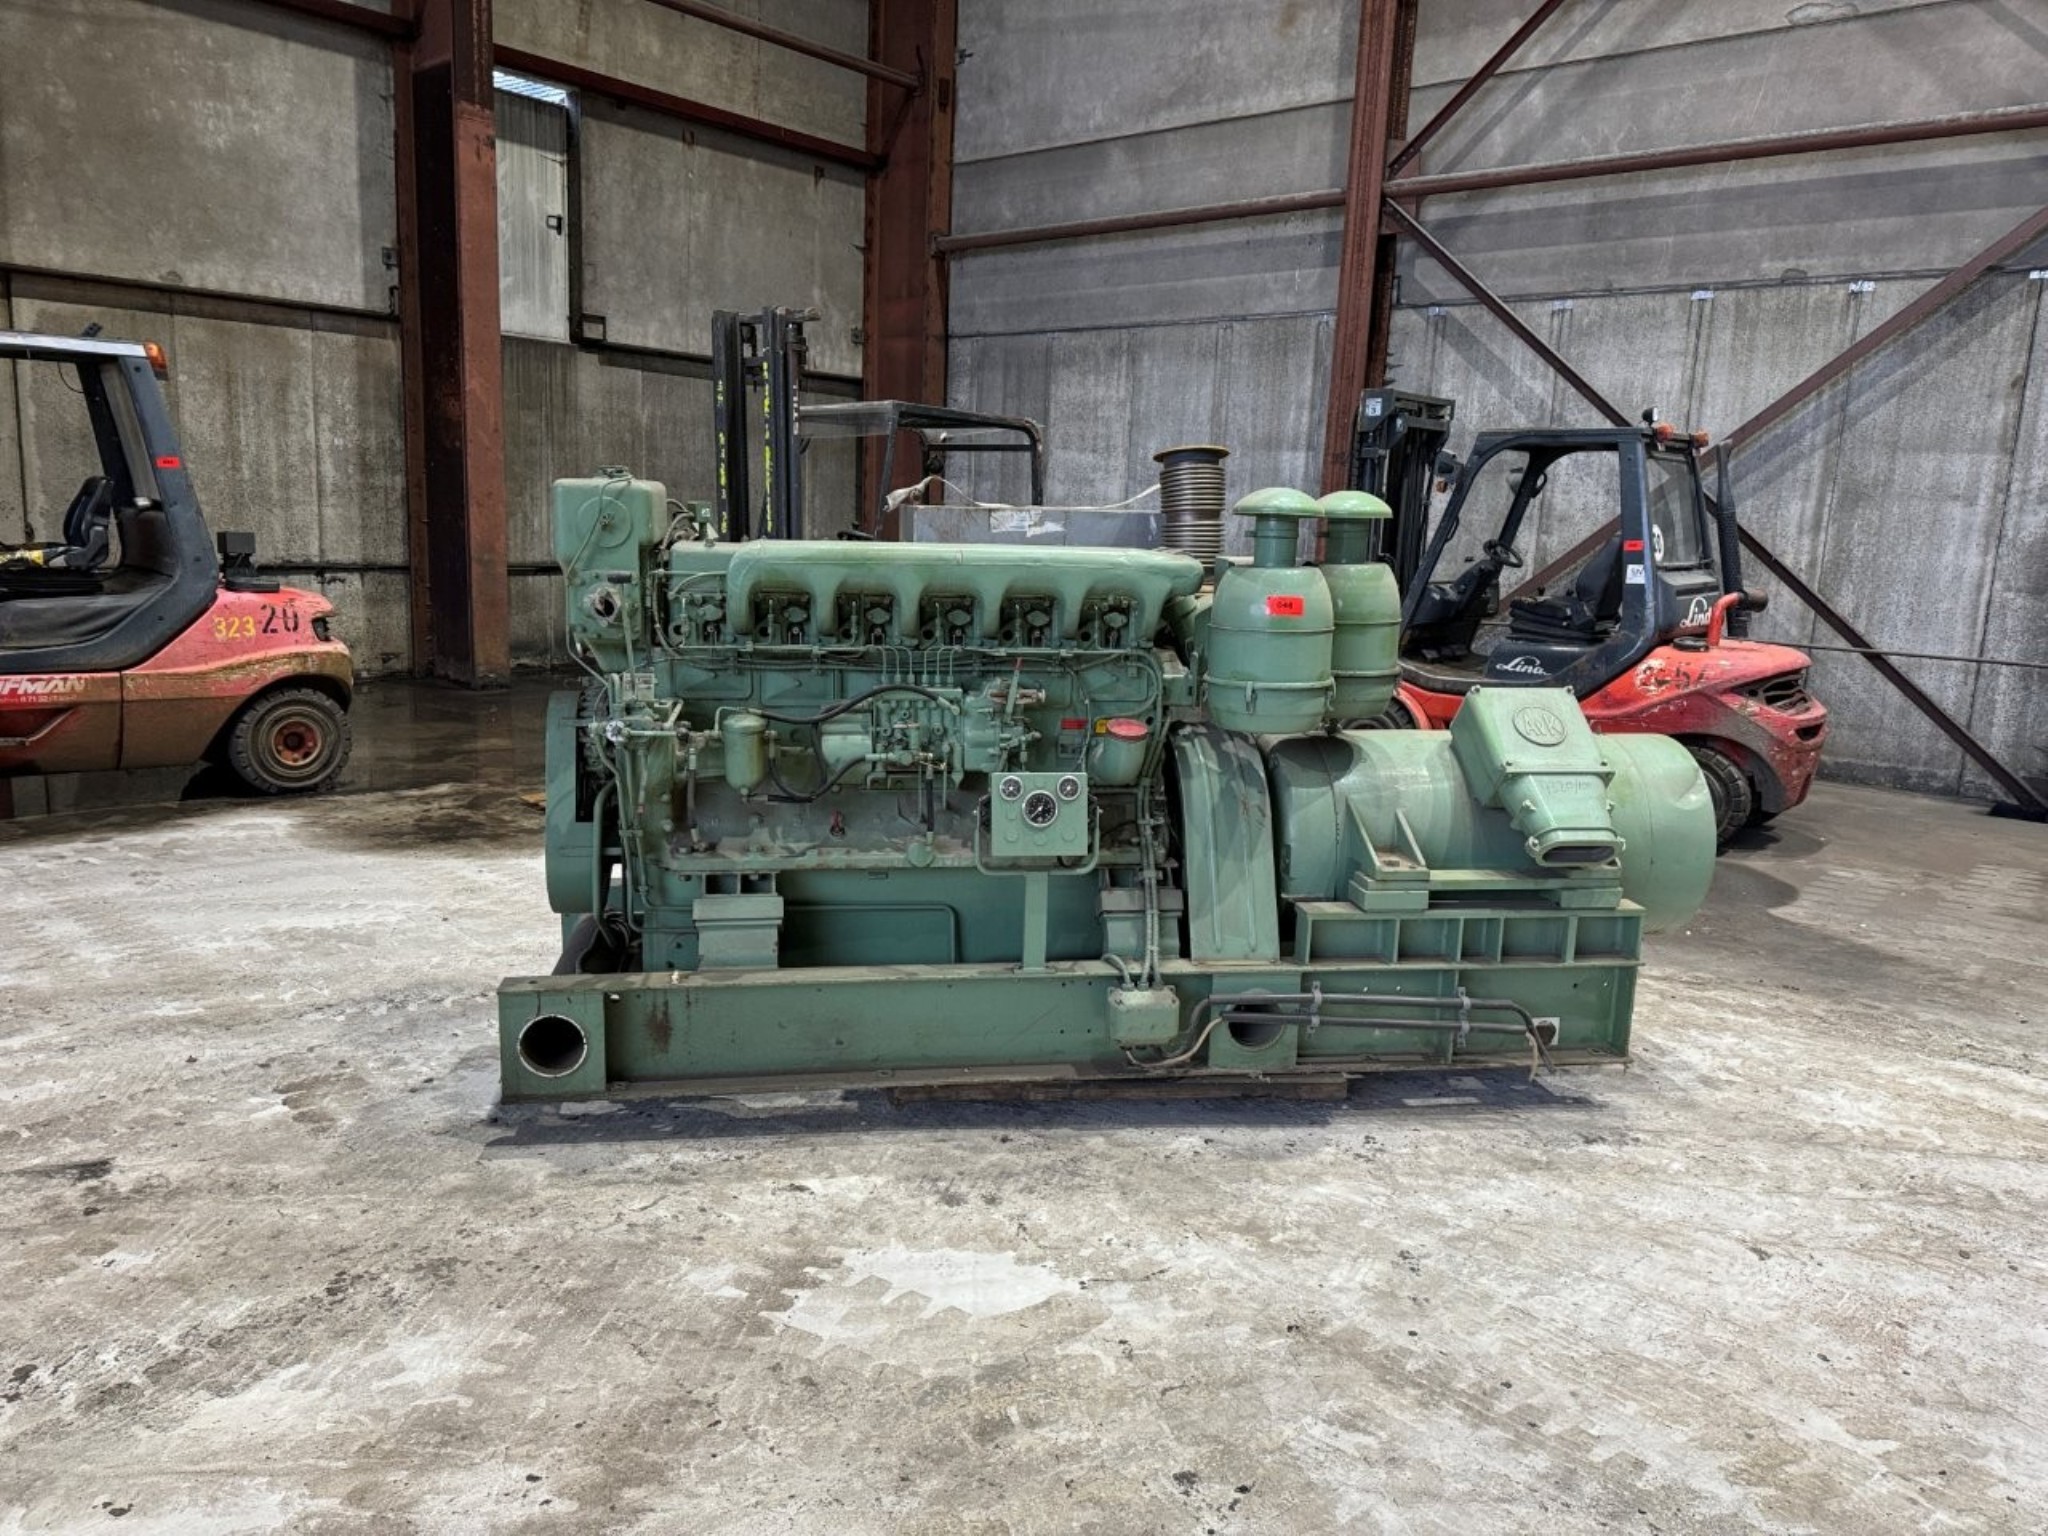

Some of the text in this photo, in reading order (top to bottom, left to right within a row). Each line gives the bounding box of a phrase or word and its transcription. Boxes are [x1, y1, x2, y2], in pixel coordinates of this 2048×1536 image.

[213, 603, 299, 637] 323 20
[1680, 597, 1712, 628] Lind
